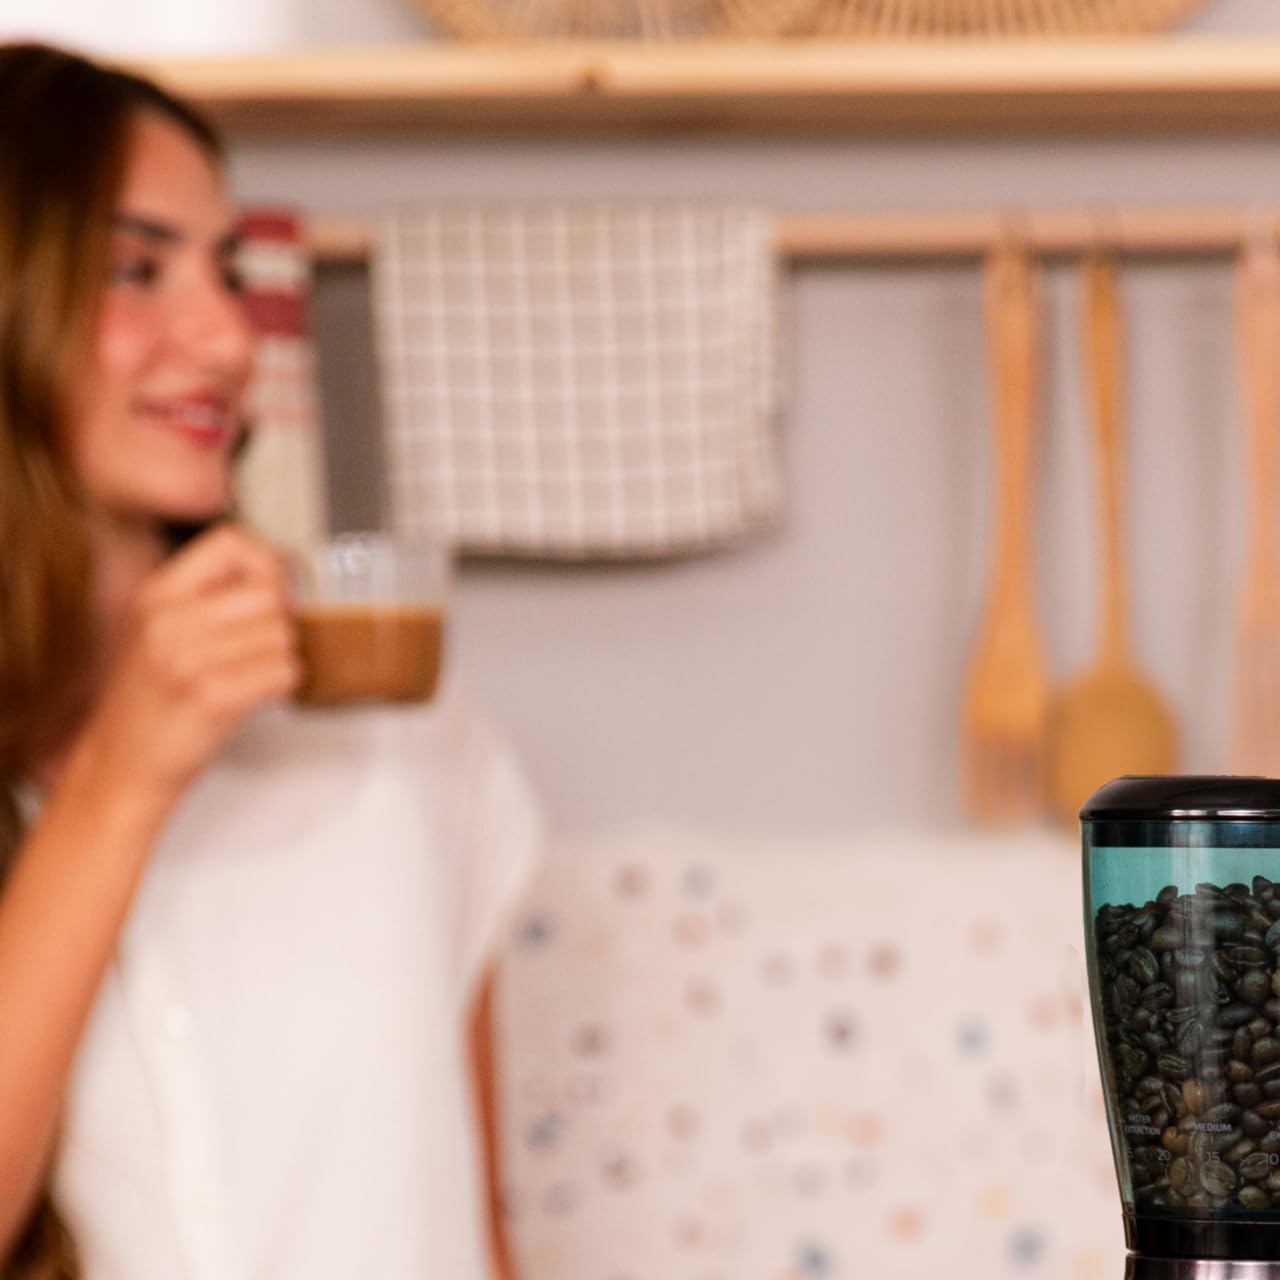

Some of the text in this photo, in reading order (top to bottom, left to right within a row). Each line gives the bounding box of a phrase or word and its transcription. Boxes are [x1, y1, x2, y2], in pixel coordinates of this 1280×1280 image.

[1194, 1122, 1232, 1132] MEDIUM
[1157, 1148, 1171, 1161] 20
[1206, 1151, 1220, 1163] 15
[1264, 1153, 1280, 1165] 10
